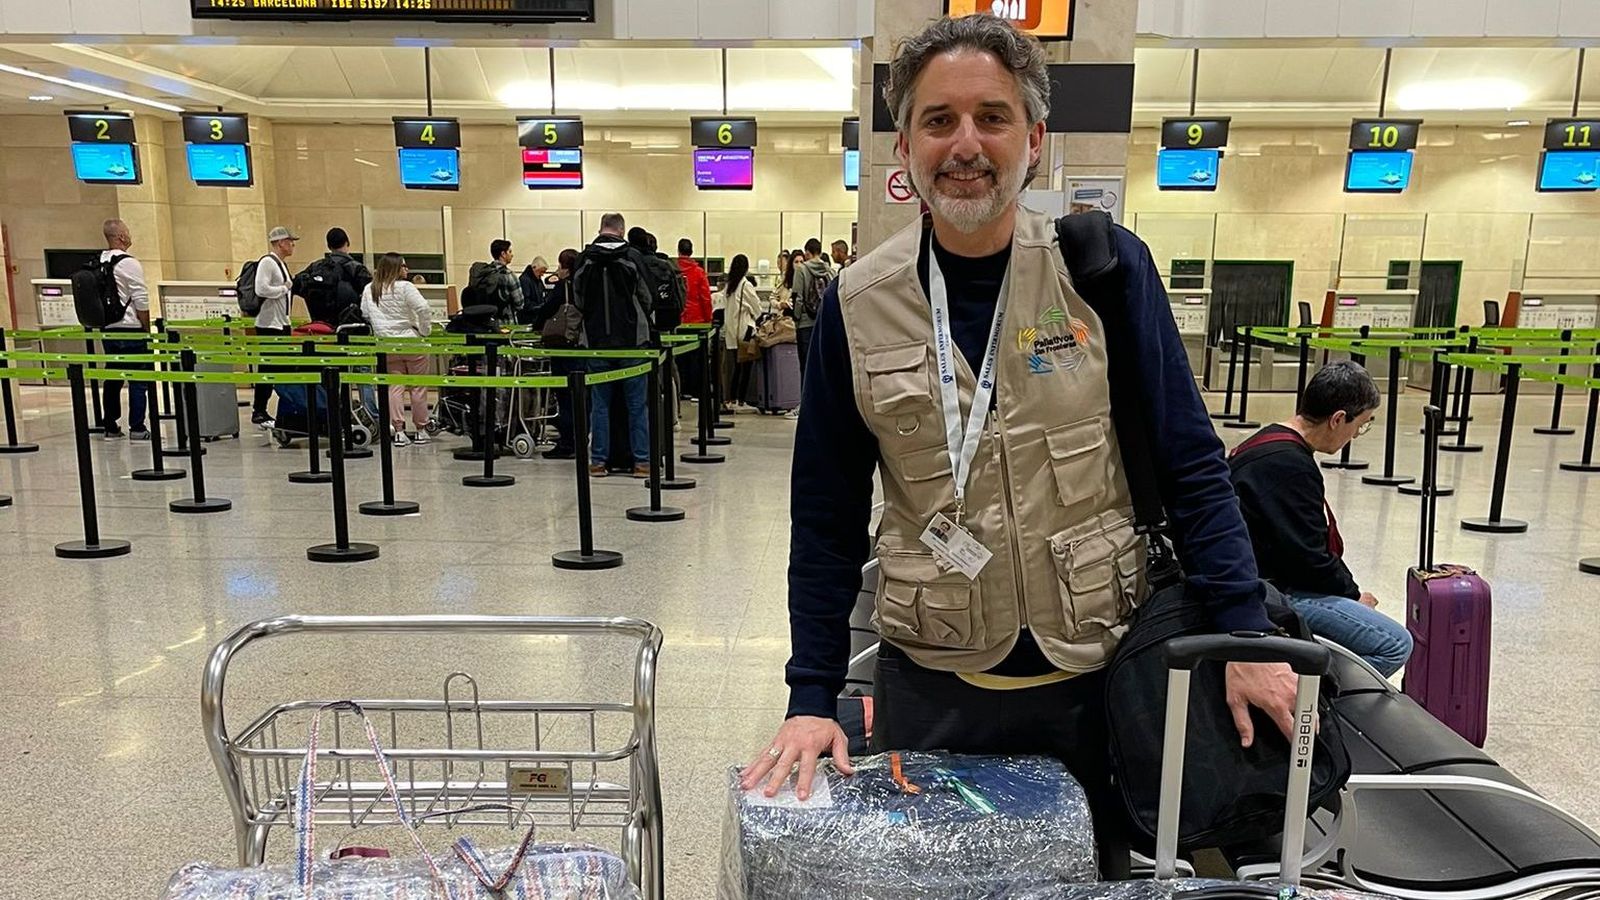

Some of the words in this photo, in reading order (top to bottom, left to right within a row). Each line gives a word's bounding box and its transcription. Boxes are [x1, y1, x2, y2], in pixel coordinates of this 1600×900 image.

[396, 0, 431, 8] 14:25
[95, 119, 111, 140] 2
[209, 119, 223, 140] 3
[420, 124, 436, 145] 4
[544, 123, 558, 144] 5
[717, 123, 733, 145] 6
[1187, 123, 1203, 146] 9
[1368, 125, 1399, 147] 10
[1563, 125, 1591, 147] 11
